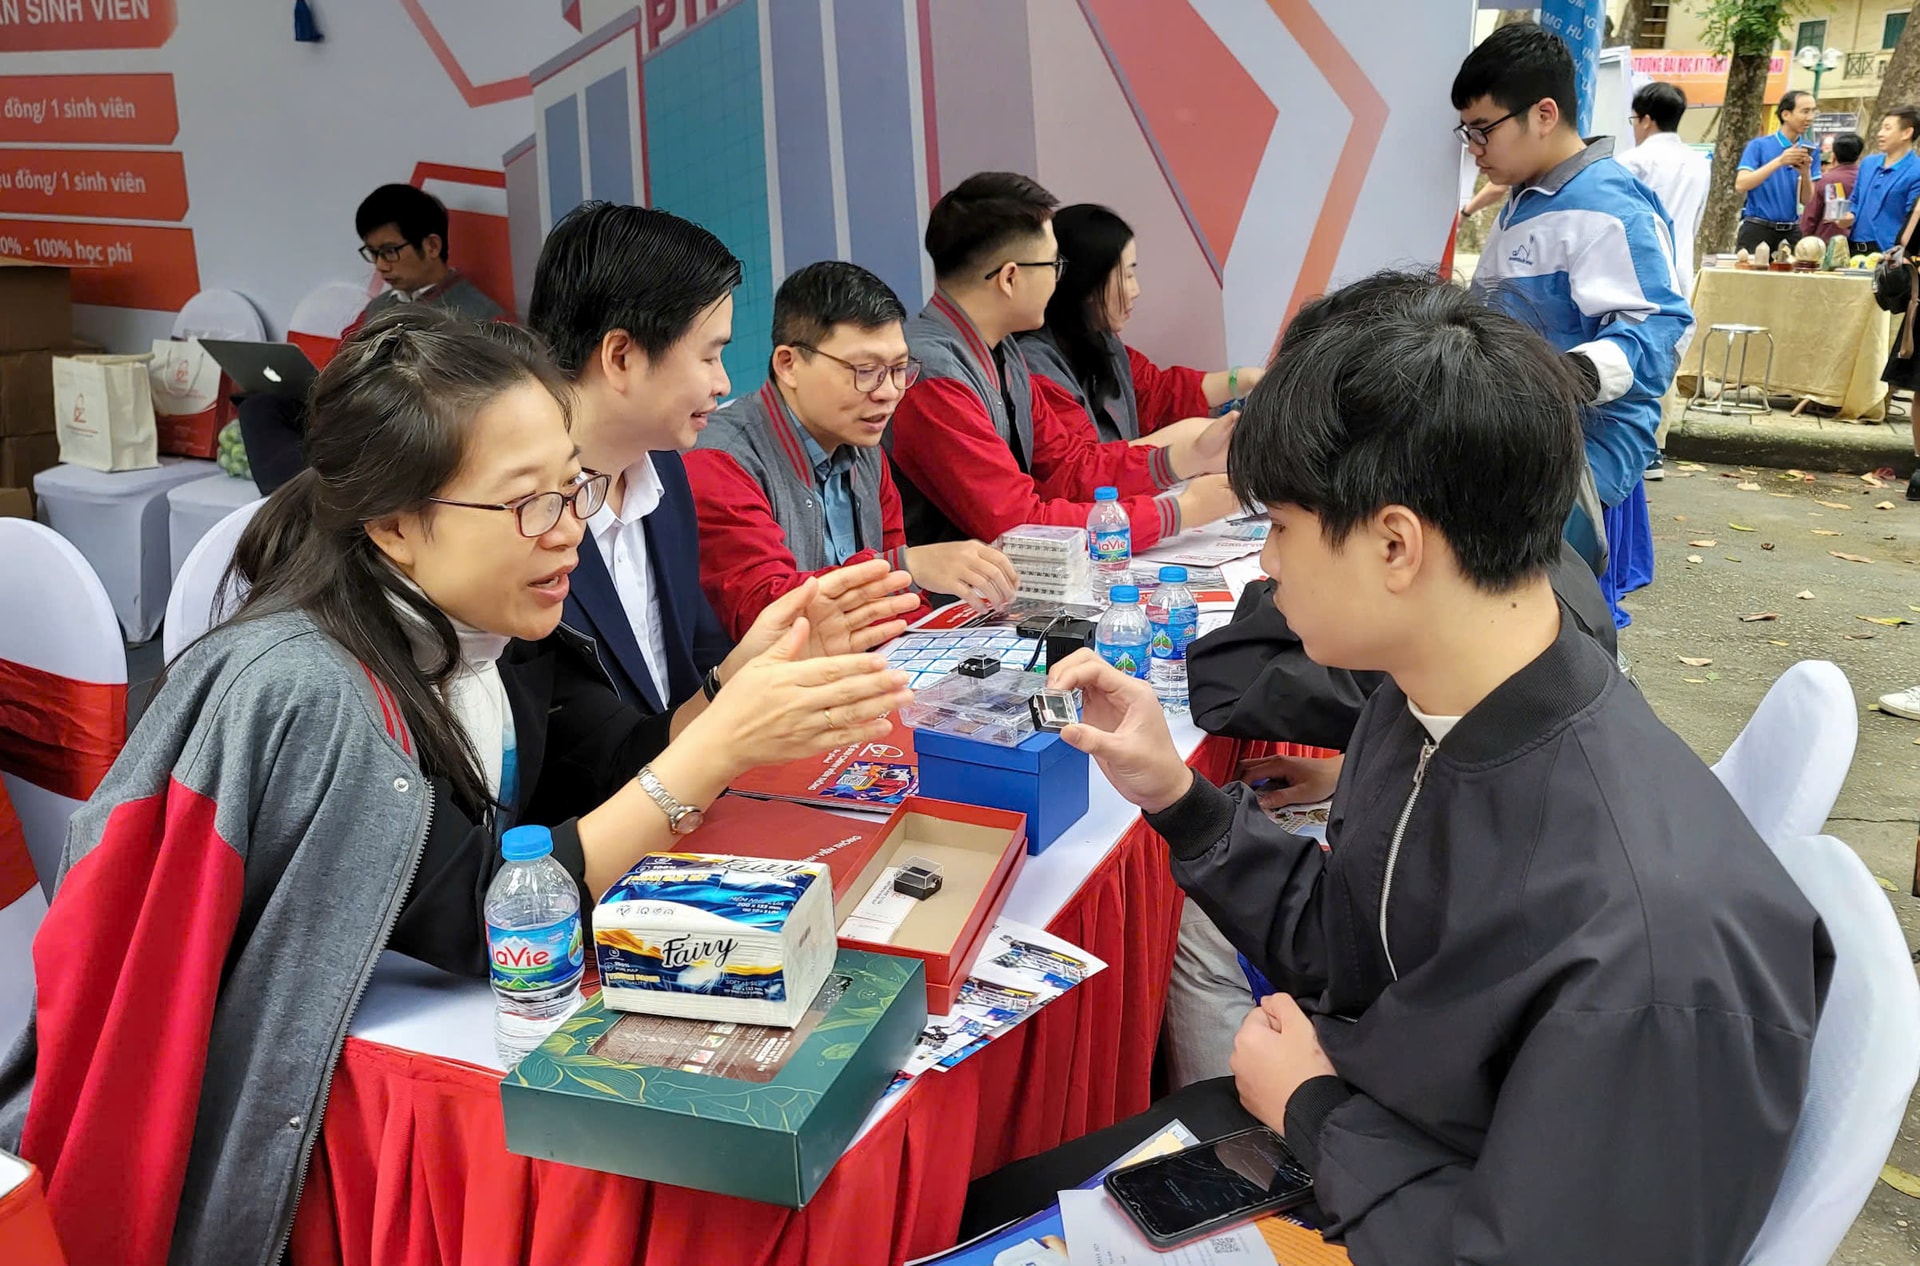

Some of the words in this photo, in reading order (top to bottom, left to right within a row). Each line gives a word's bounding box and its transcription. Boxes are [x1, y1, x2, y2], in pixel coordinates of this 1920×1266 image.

[26, 0, 83, 24] SINH
[5, 97, 46, 124] đồng/
[51, 99, 59, 117] 1
[63, 97, 97, 118] sinh
[101, 97, 136, 118] viên
[15, 168, 57, 195] đồng/
[62, 171, 69, 190] 1
[74, 171, 108, 191] sinh
[111, 171, 146, 193] viên
[34, 238, 72, 258] 100%
[76, 239, 104, 265] học
[108, 242, 133, 267] phí
[491, 944, 549, 967] laVie
[662, 933, 739, 968] Fairy
